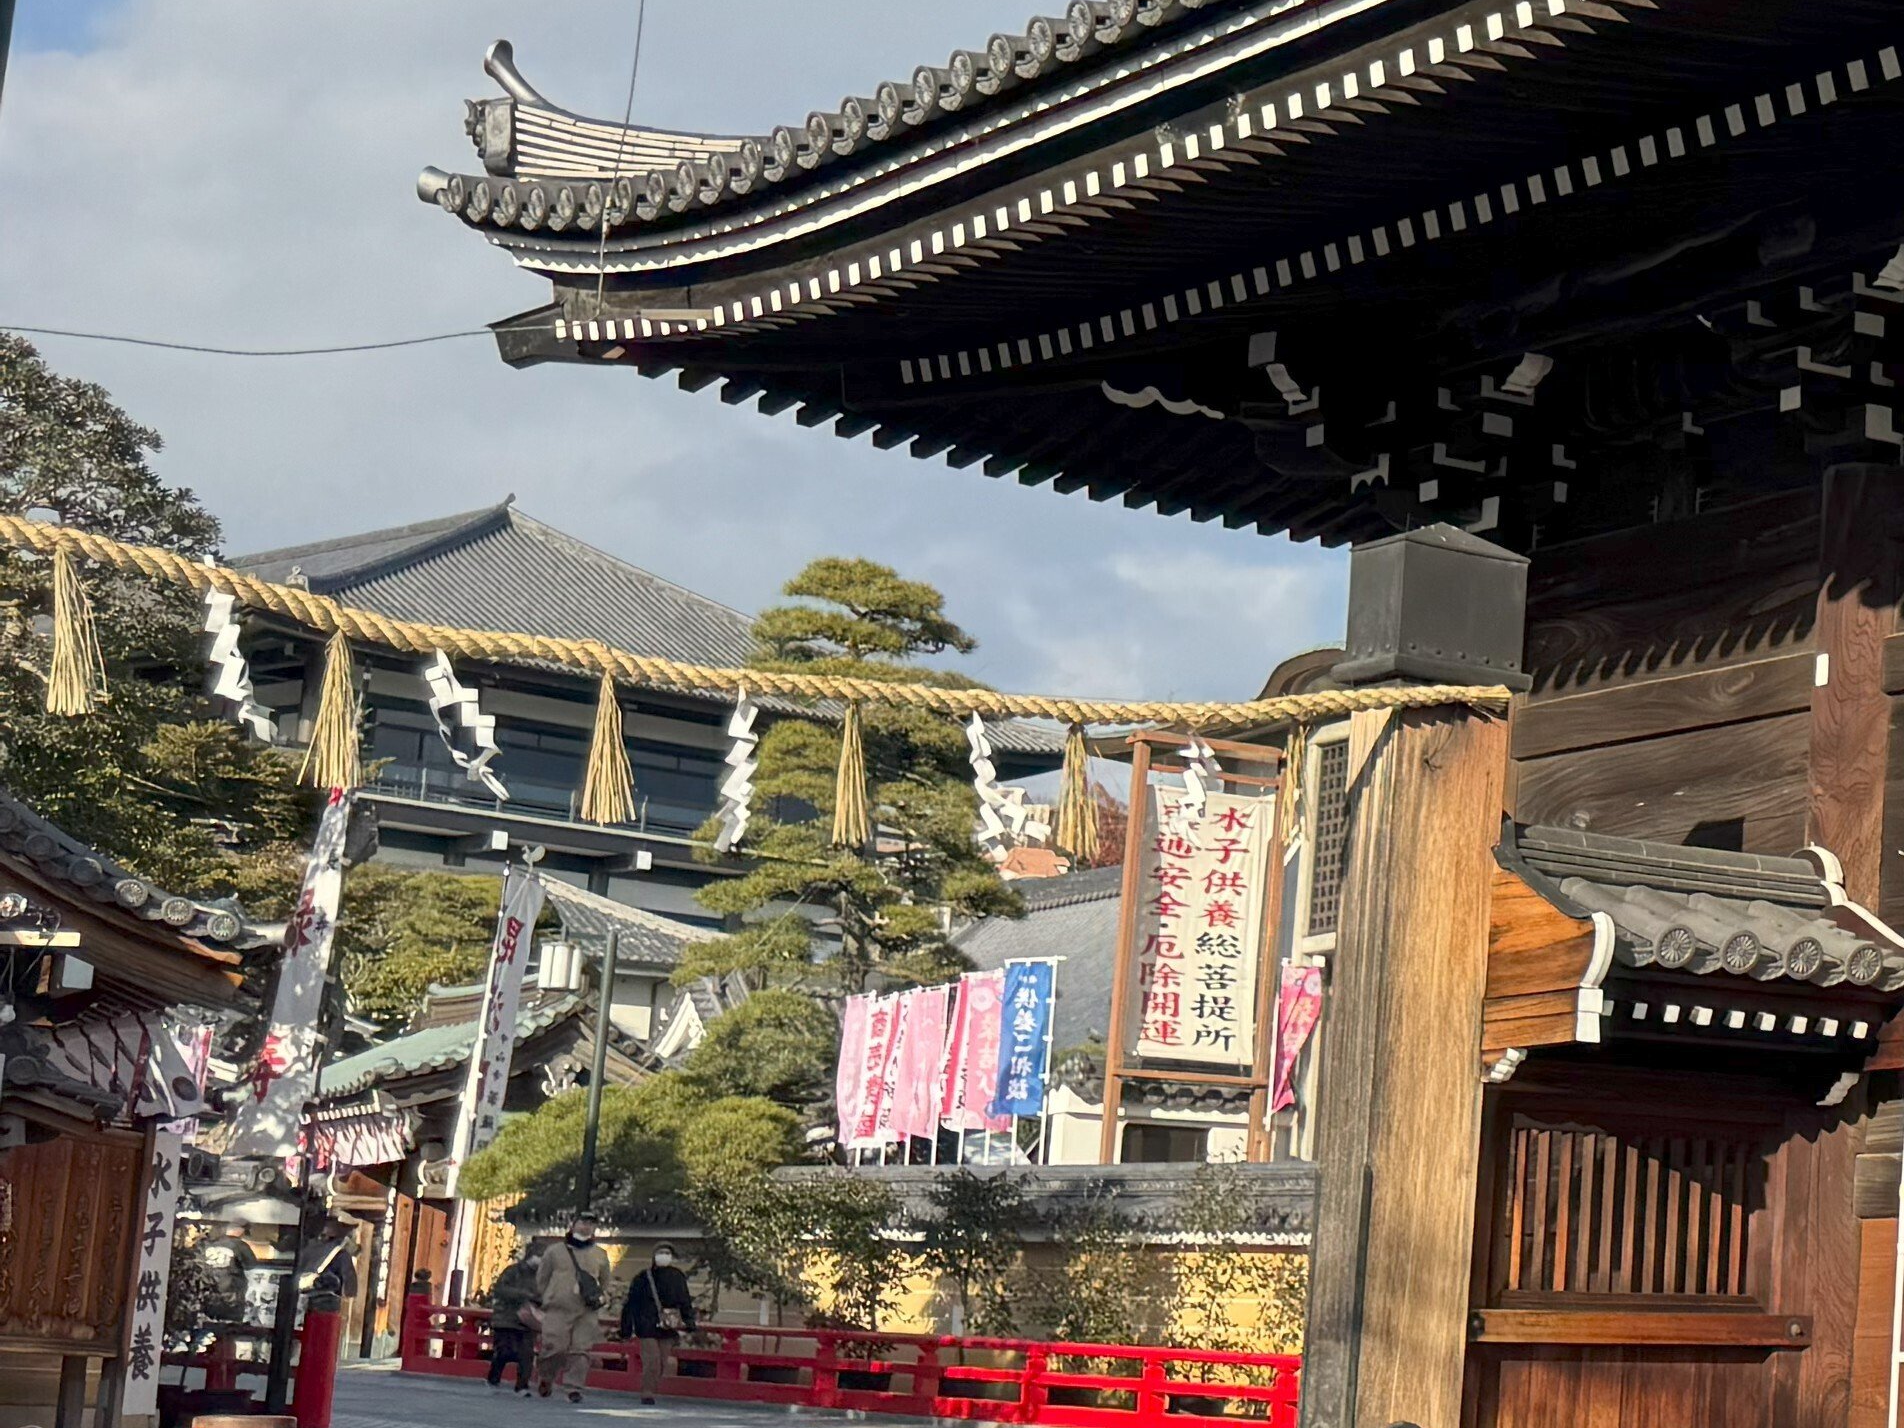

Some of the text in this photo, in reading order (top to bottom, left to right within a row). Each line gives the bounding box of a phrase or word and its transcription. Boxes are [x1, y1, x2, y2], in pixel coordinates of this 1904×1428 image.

[1190, 806, 1256, 1053] 水子供養総菩提所
[126, 1151, 174, 1381] 水子供養
